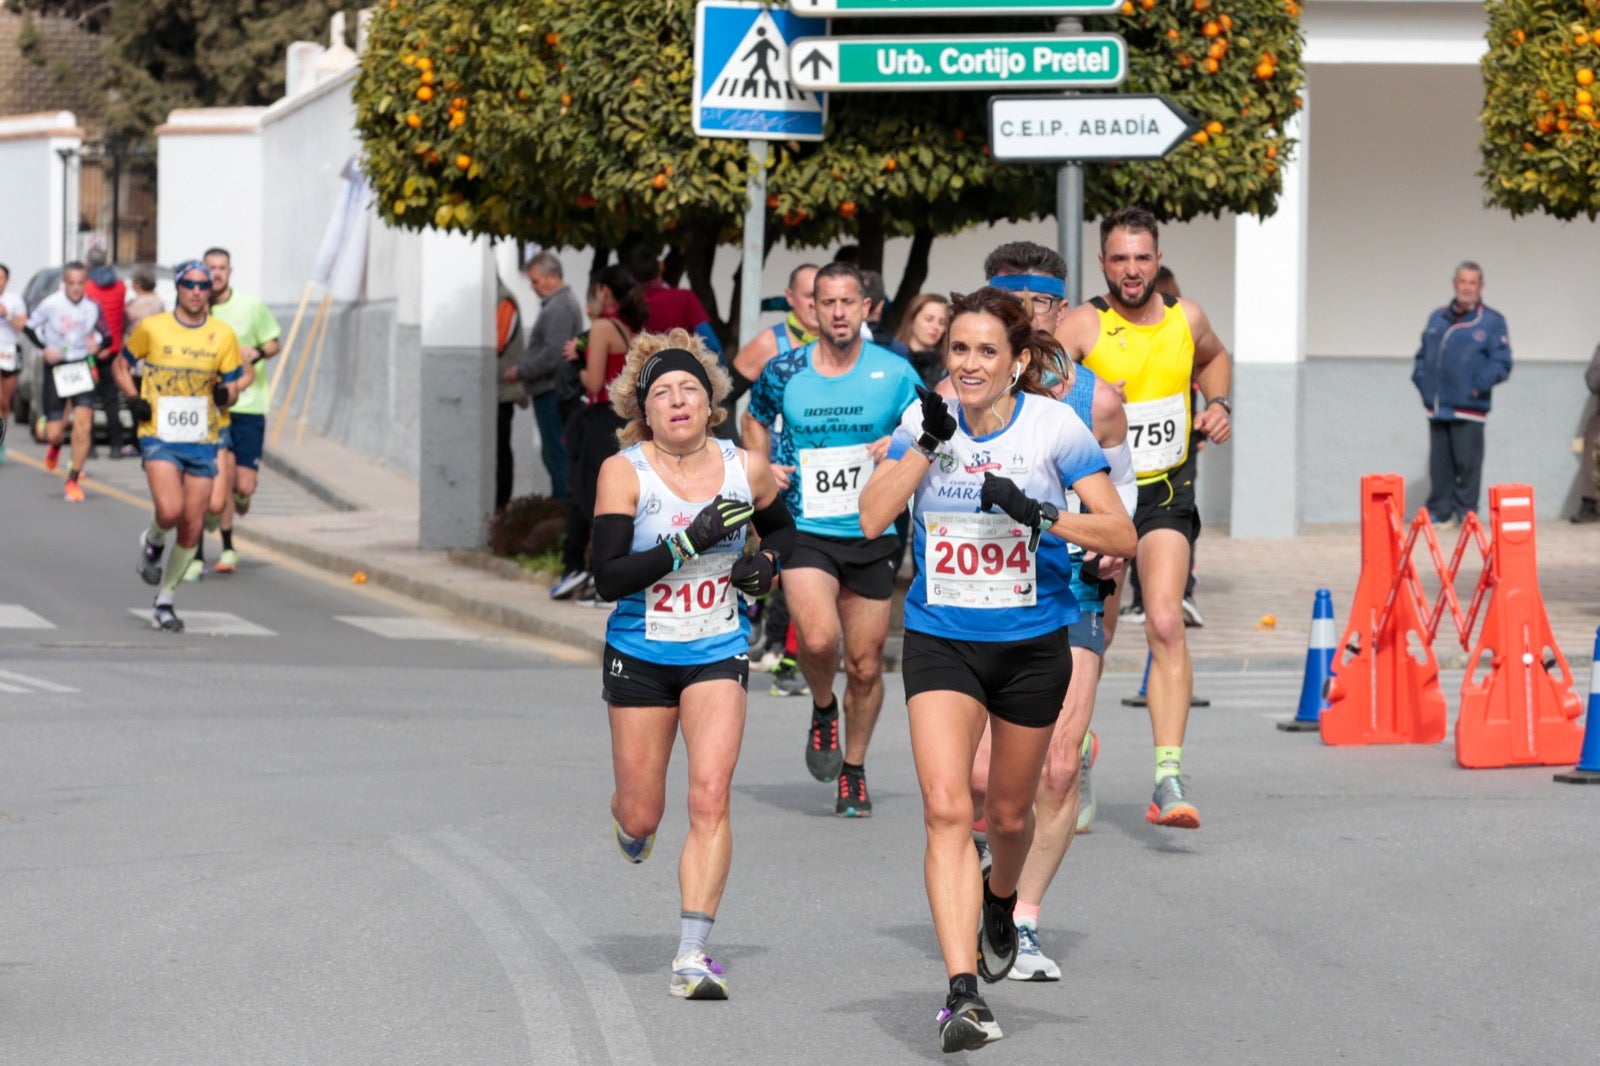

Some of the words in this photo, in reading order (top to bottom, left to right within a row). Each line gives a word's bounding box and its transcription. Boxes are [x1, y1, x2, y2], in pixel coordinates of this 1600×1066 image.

[877, 48, 932, 75] Urb.
[939, 47, 1026, 79] Cortijo
[1033, 46, 1110, 73] Pretel
[1000, 120, 1068, 137] C.E.I.P.
[1079, 113, 1160, 135] ABADÍA
[168, 411, 199, 426] 660
[1128, 419, 1175, 448] 759
[971, 450, 991, 467] 35
[816, 466, 861, 493] 847
[934, 541, 1030, 575] 2094
[652, 575, 731, 613] 2107
